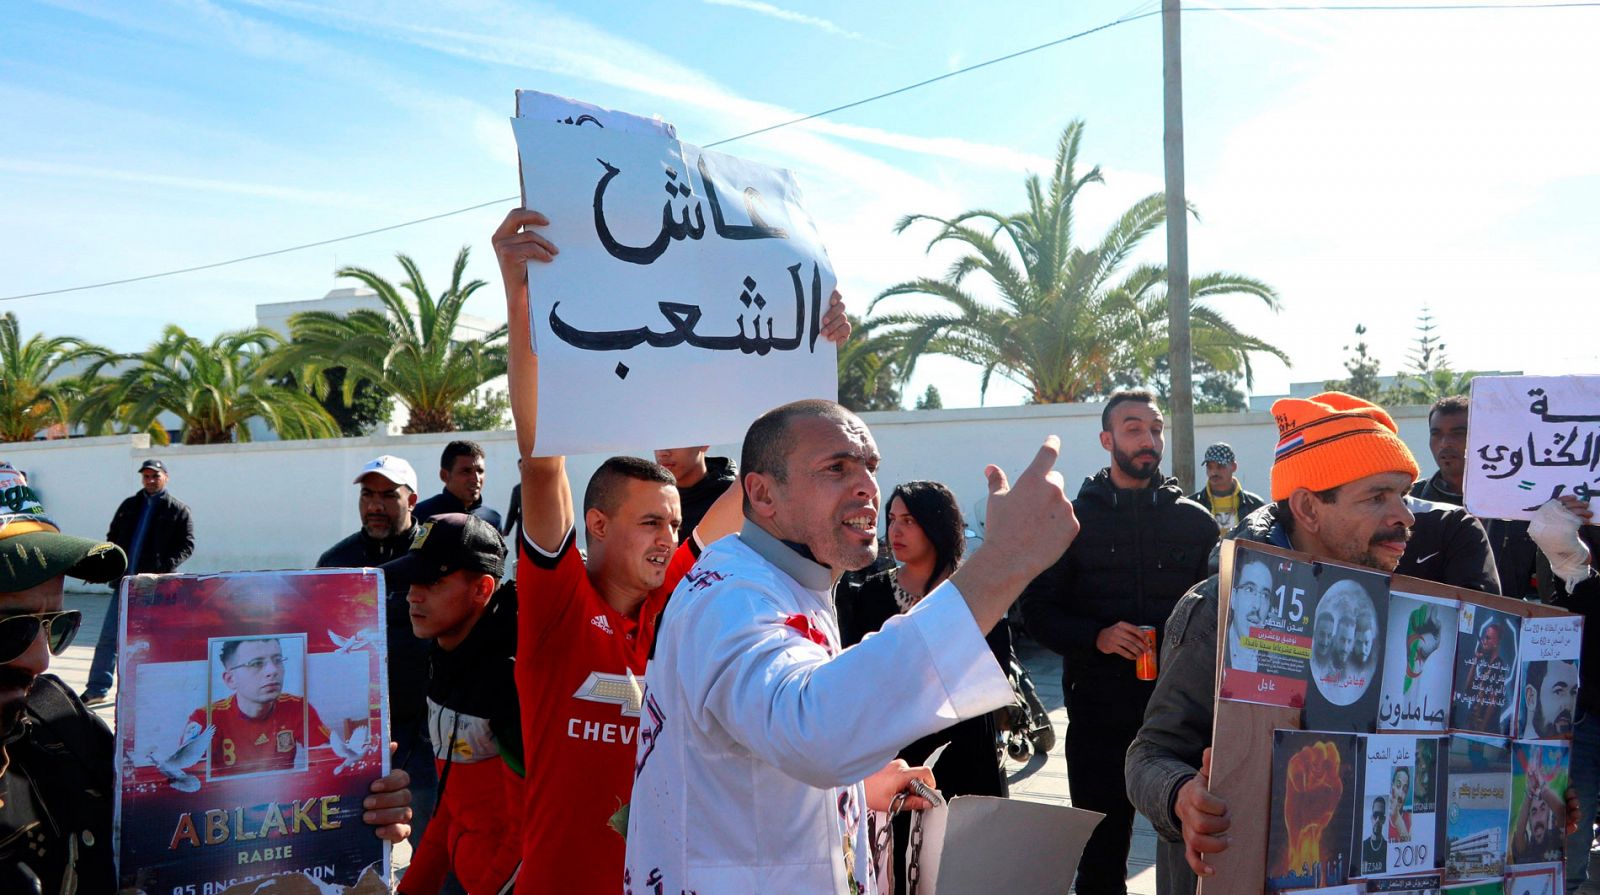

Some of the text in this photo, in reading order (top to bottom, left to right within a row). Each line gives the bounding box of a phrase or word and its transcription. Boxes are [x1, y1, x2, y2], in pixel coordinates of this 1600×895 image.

[594, 154, 790, 265] عاش
[549, 261, 821, 380] الشعب
[1275, 584, 1305, 622] 15
[1257, 678, 1276, 691] عاجل
[1380, 694, 1445, 727] صامدون
[568, 718, 640, 745] CHEV
[222, 738, 237, 767] 8
[1368, 747, 1410, 764] عاش الشعب
[168, 795, 342, 850] ABLAKE
[238, 845, 293, 865] RABIE
[1393, 844, 1427, 868] 2019
